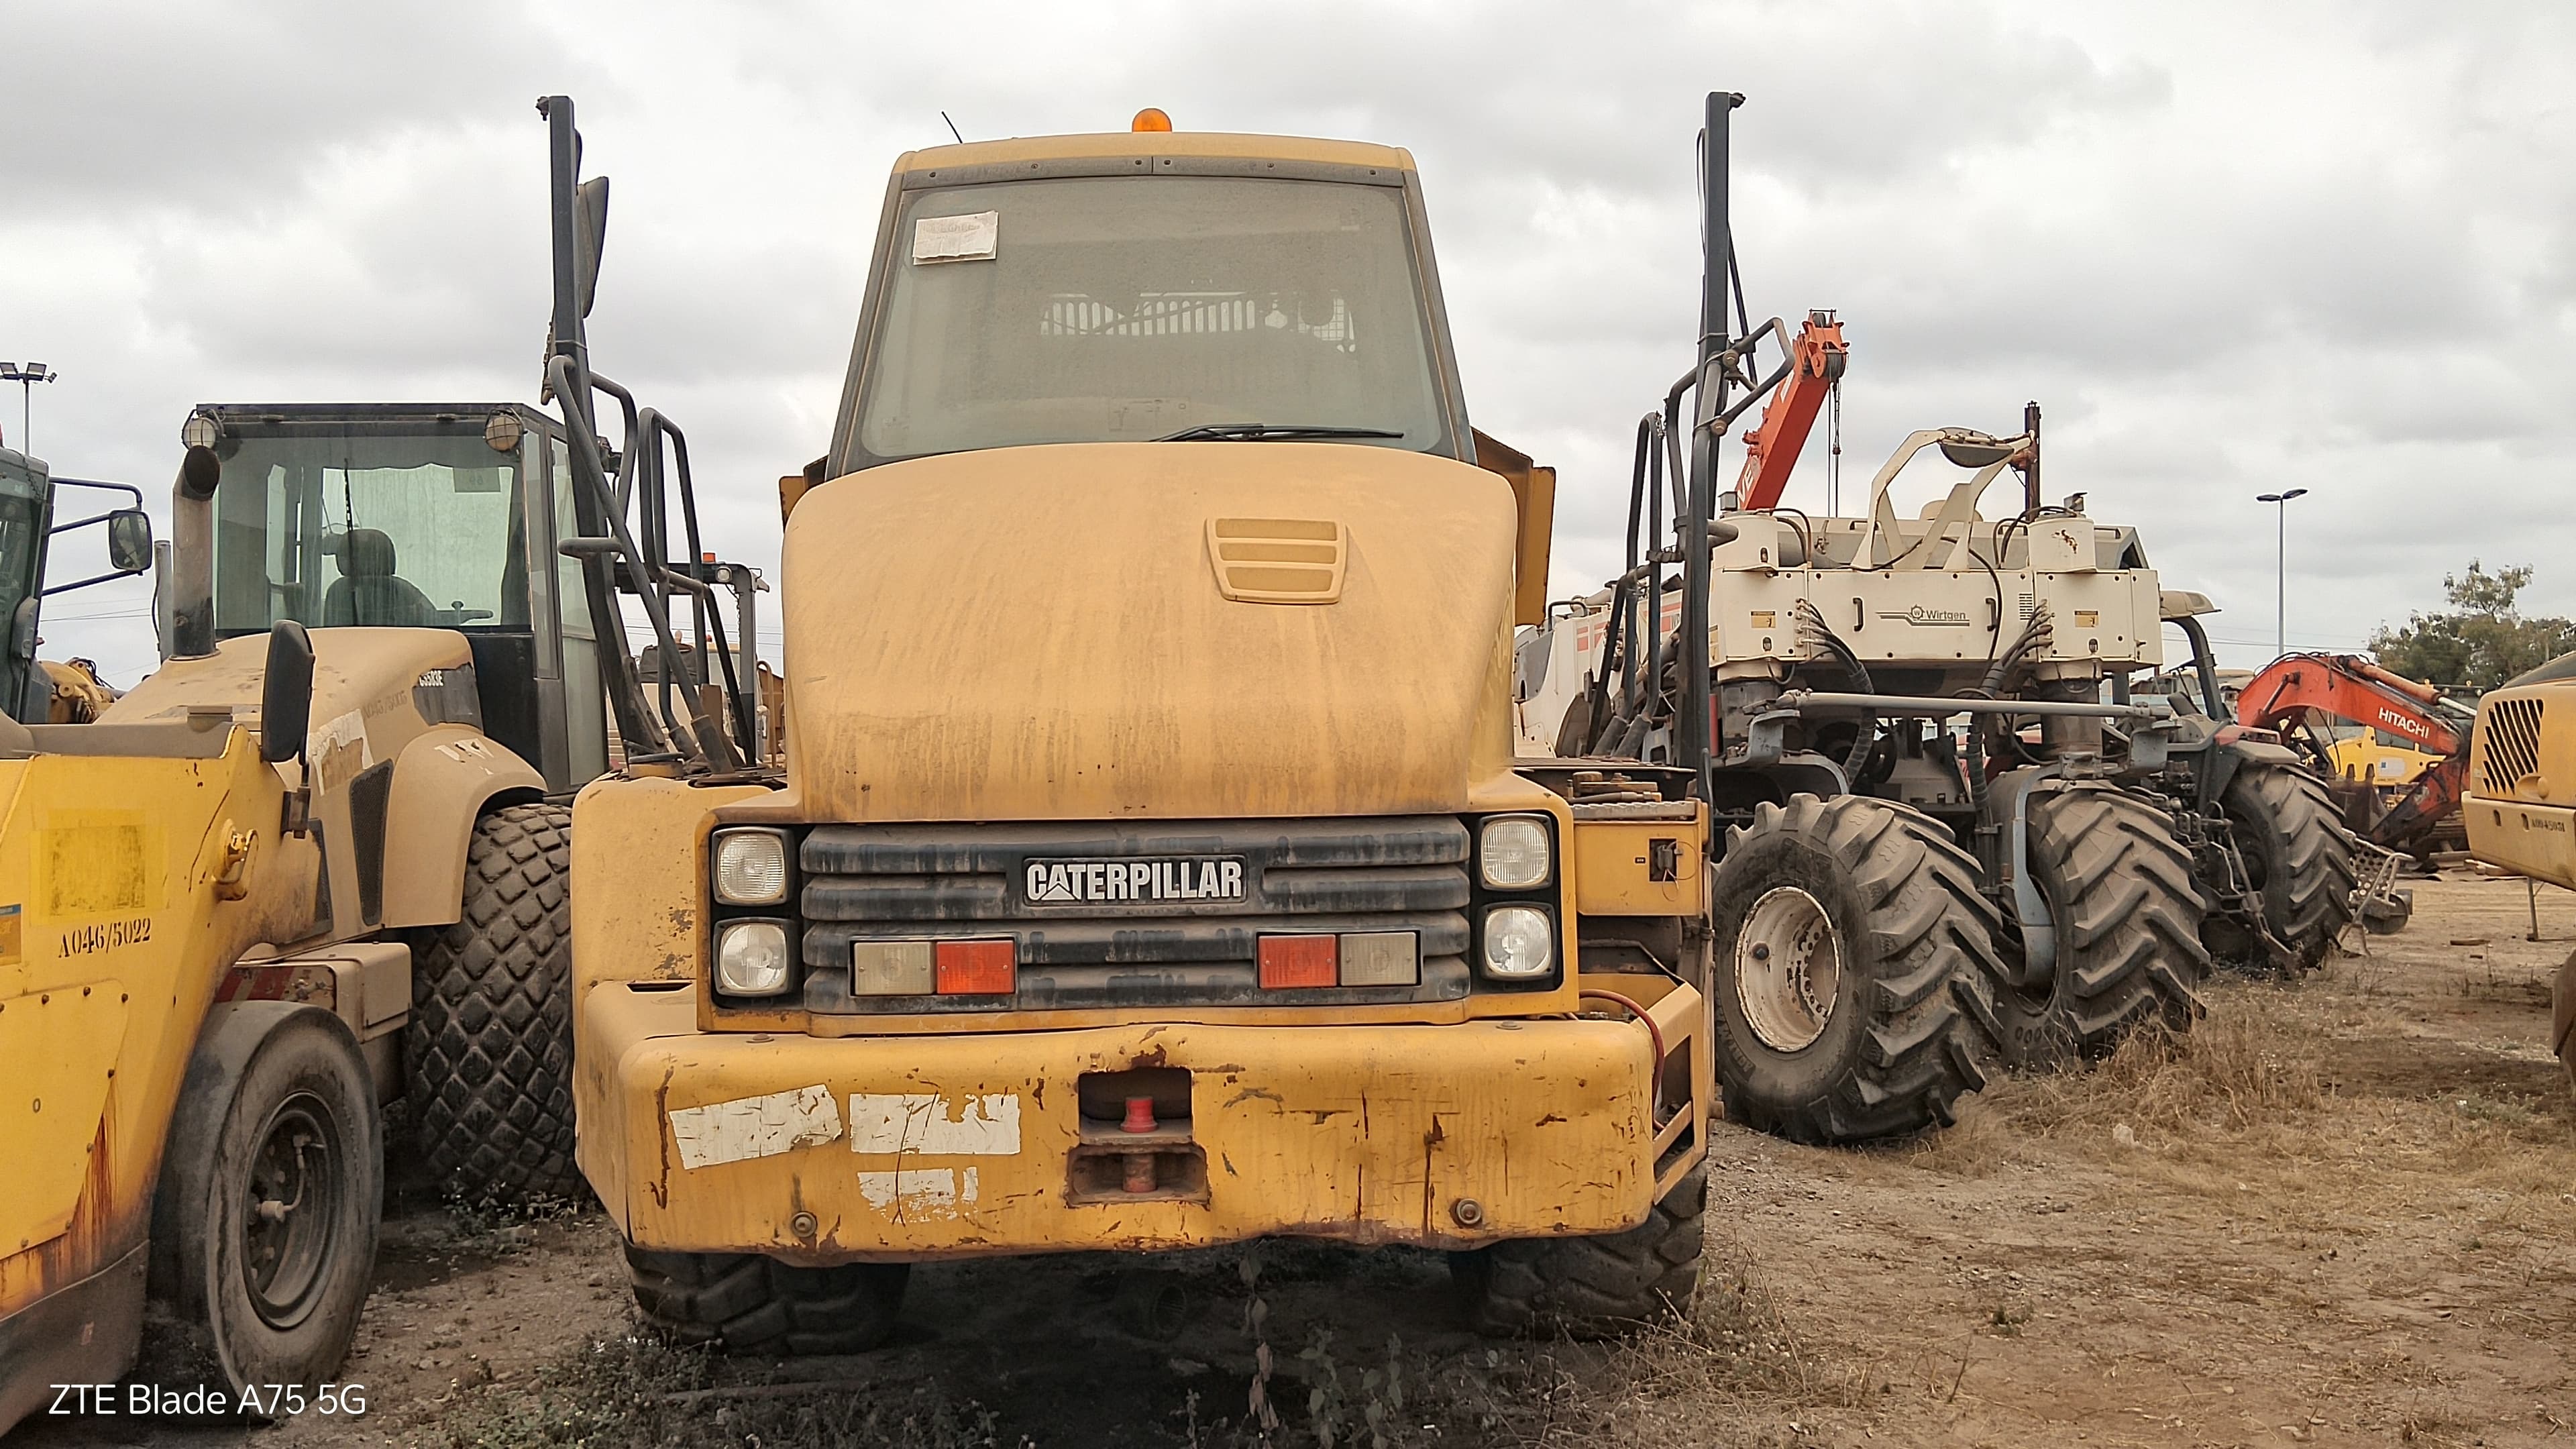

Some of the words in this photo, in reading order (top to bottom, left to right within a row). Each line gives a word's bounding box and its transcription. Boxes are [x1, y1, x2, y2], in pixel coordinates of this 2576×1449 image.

[1926, 610, 1966, 621] Wirtgen
[2378, 706, 2430, 739] HITACHI
[1027, 861, 1242, 900] CATERPILLAR
[58, 918, 151, 957] A046/5022
